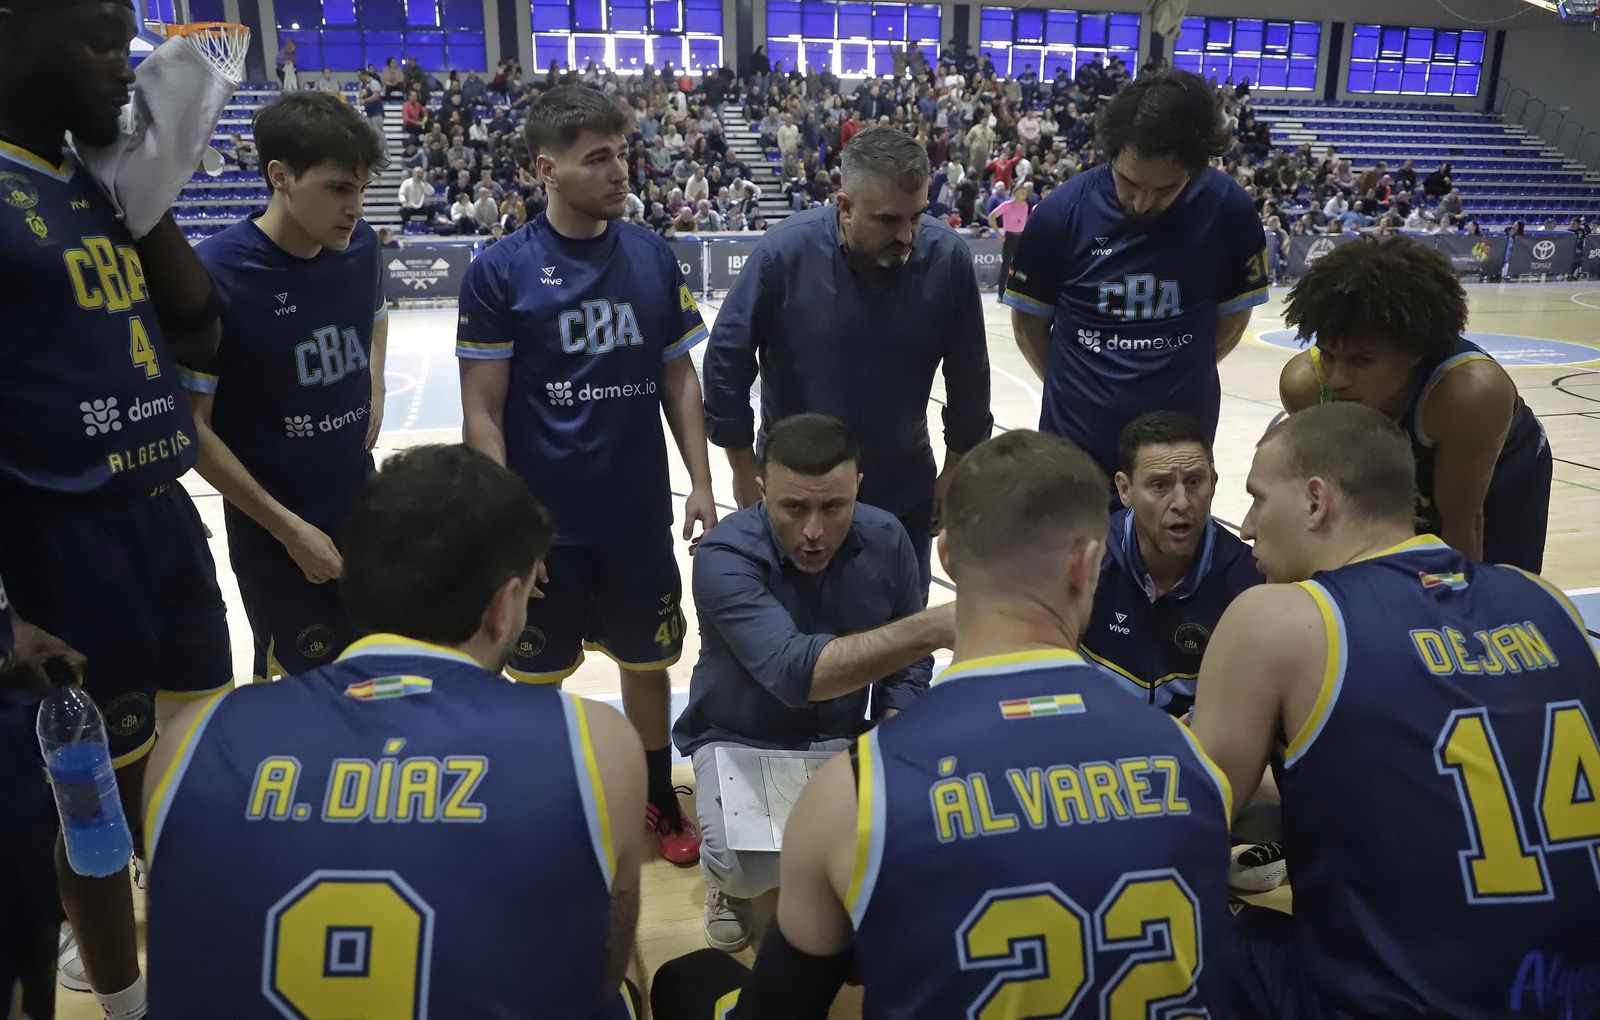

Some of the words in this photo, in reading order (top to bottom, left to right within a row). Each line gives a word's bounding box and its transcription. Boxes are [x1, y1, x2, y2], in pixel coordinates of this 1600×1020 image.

[63, 236, 150, 313] CBA
[1091, 248, 1113, 256] vive
[540, 277, 563, 286] vive
[1097, 273, 1185, 321] CBA
[274, 304, 297, 316] vive
[558, 299, 645, 355] CBA
[129, 316, 161, 380] 4
[295, 325, 369, 387] CBA
[1106, 332, 1193, 351] damex.io
[578, 378, 657, 401] damex.io
[1109, 622, 1131, 636] vive
[1409, 621, 1560, 676] DEJAN
[245, 755, 312, 822] A.
[321, 737, 489, 824] DÍAZ
[929, 756, 1192, 844] ÁLVAREZ
[1432, 699, 1600, 905] 14
[261, 869, 436, 1020] 9
[954, 867, 1204, 1020] 22
